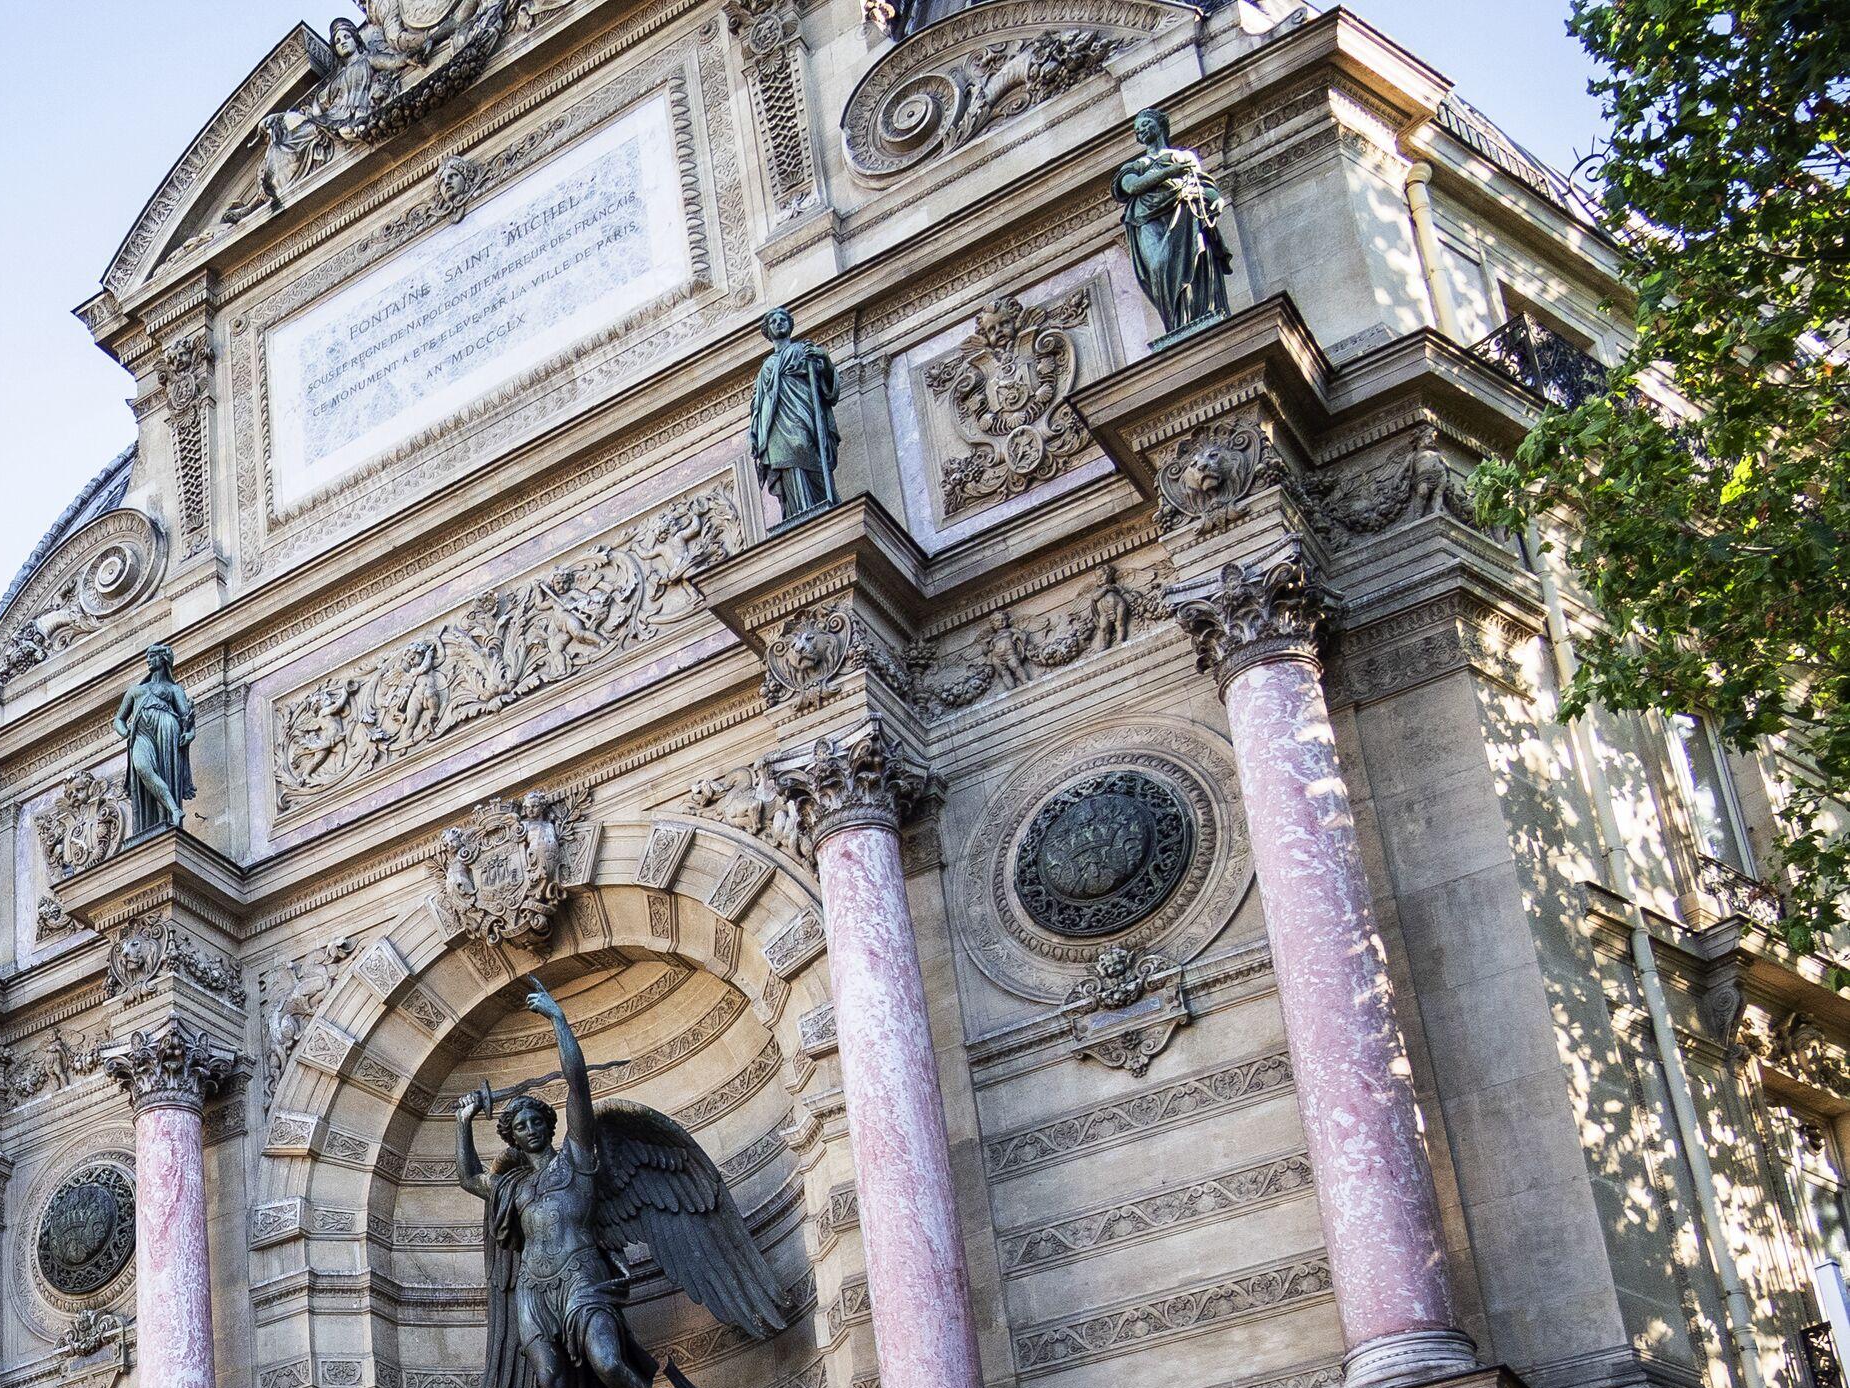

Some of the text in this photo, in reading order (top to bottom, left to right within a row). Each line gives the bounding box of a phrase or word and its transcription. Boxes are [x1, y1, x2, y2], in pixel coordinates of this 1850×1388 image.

[307, 371, 335, 394] SOUS
[389, 329, 406, 345] DE
[406, 290, 468, 334] NAPOLEON
[483, 244, 547, 288] EMPEREUR
[550, 228, 572, 249] DES
[312, 402, 327, 417] CE
[330, 359, 399, 408] MONUMENT
[483, 297, 508, 317] PAR
[511, 286, 527, 300] LA
[531, 260, 570, 287] VILLE
[574, 247, 591, 264] DE
[596, 221, 636, 250] PARIS
[349, 195, 581, 340] FONTAINE SAINT MICHEL
[426, 312, 526, 380] AN MDCCCLX
